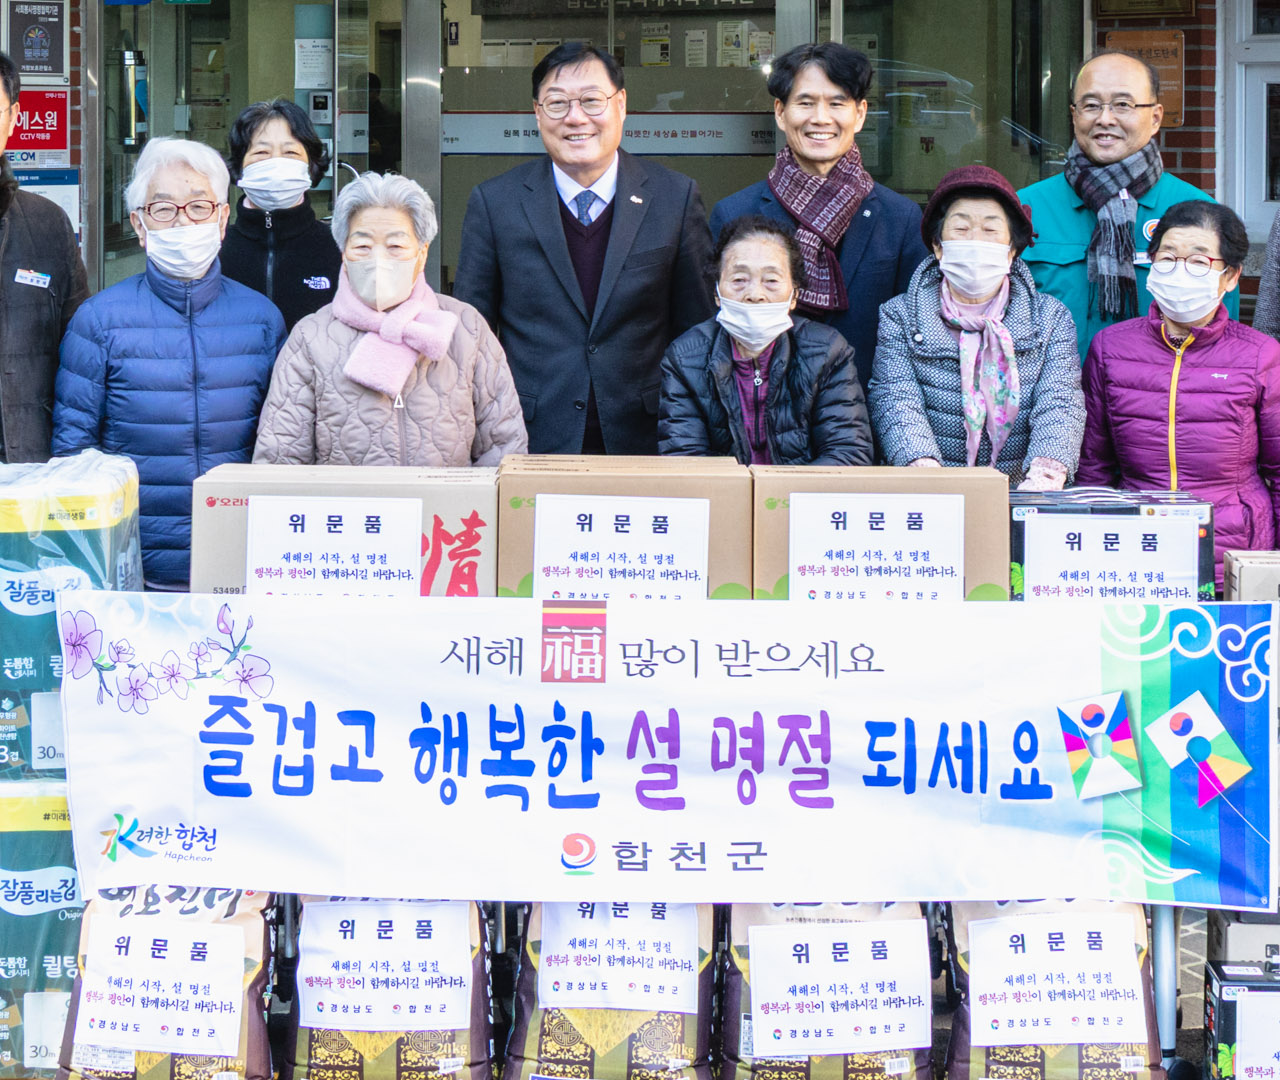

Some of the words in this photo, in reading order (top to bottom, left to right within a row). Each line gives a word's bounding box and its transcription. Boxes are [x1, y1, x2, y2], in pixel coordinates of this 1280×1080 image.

[15, 110, 58, 131] 에스원
[36, 132, 51, 140] 작동중
[624, 129, 651, 139] 따뜻한
[654, 128, 678, 138] 세상을
[681, 128, 723, 139] 만들어가는
[219, 497, 248, 507] 오리
[824, 549, 854, 560] 새해의
[862, 550, 886, 561] 시작,
[893, 550, 902, 561] 설
[909, 550, 930, 562] 명절
[798, 565, 826, 576] 행복과
[831, 565, 858, 576] 평안이
[864, 565, 911, 577] 함께하시길
[916, 566, 957, 577] 바랍니다.
[213, 586, 240, 595] 53499
[440, 635, 524, 678] 새해
[542, 626, 604, 681] 福
[619, 638, 700, 680] 많이
[716, 638, 885, 680] 받으세요
[198, 695, 384, 798] 즐겁고
[408, 698, 605, 812] 행복한
[625, 707, 686, 811] 설
[710, 708, 835, 810] 명절
[861, 717, 1054, 801] 되세요
[174, 821, 217, 852] 합천
[163, 849, 214, 864] Hapcheon
[611, 840, 768, 873] 합천군
[331, 960, 361, 973] 새해의
[369, 961, 394, 972] 시작,
[401, 961, 411, 972] 설
[418, 961, 439, 973] 명절
[305, 976, 333, 988] 행복과
[337, 976, 365, 989] 평안이
[370, 977, 419, 989] 함께하시길
[425, 976, 466, 988] 바랍니다.
[436, 1040, 468, 1057] 20kg
